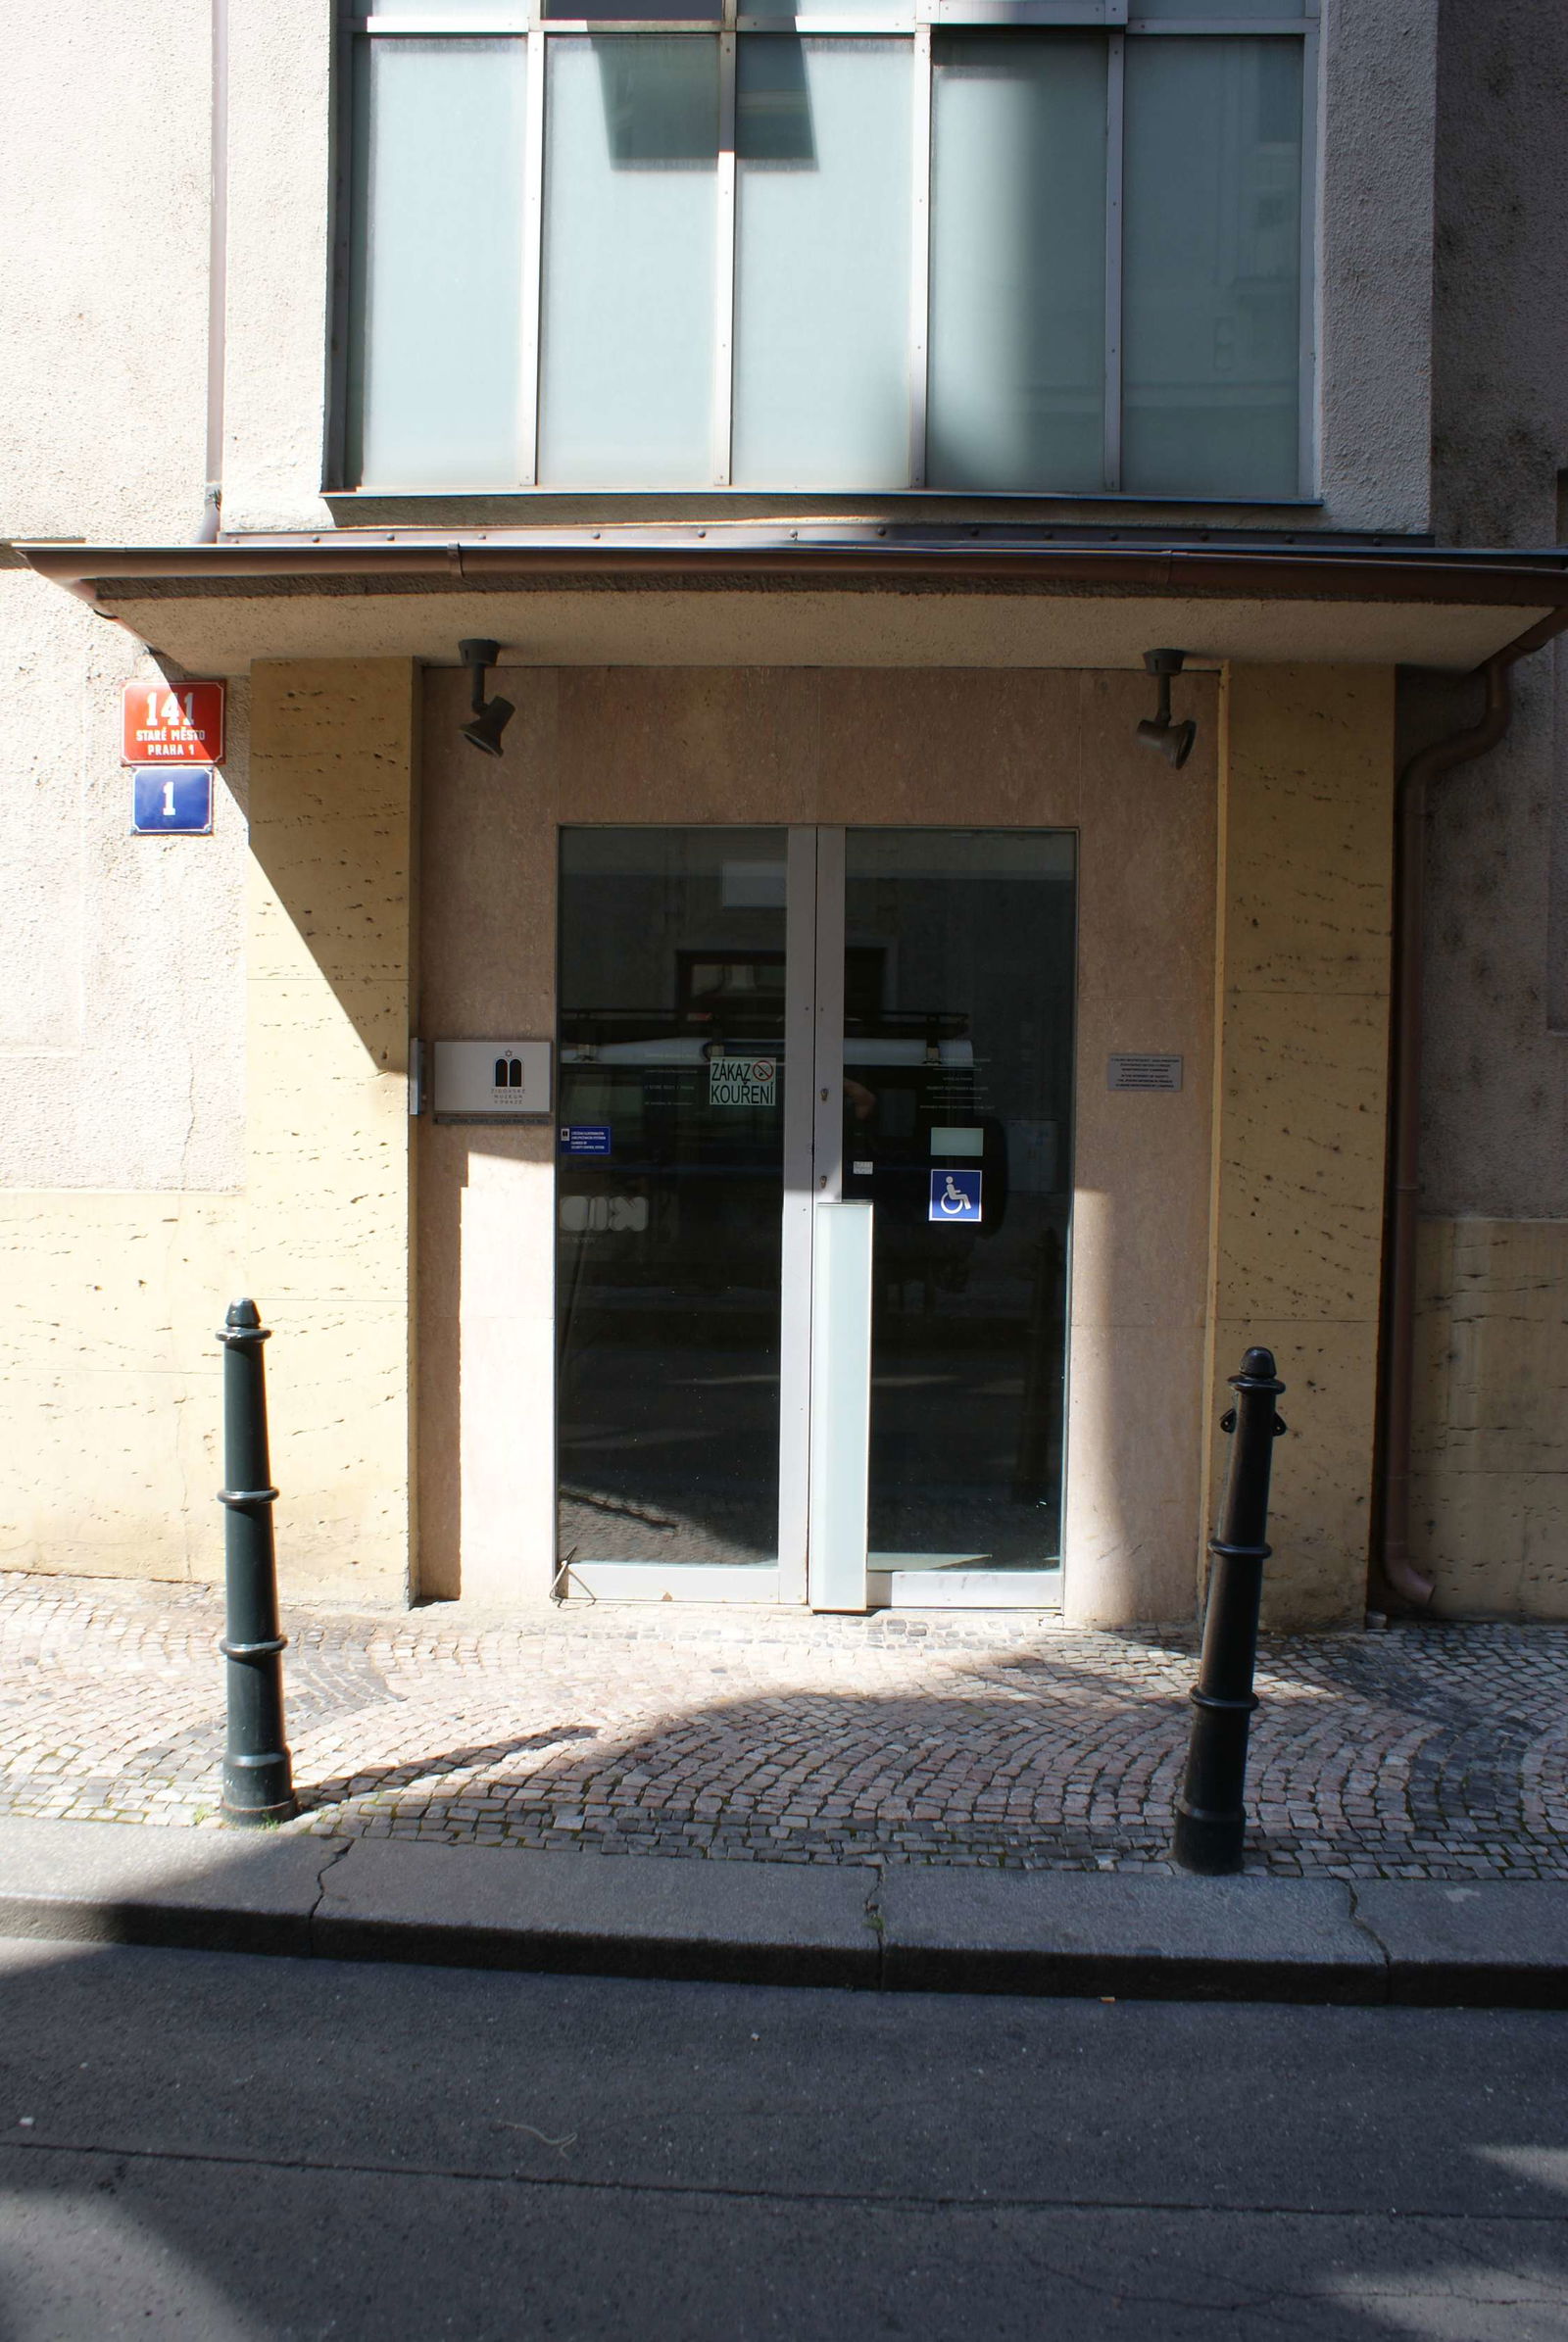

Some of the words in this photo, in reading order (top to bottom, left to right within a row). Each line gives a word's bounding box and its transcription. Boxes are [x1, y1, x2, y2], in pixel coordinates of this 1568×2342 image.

[146, 692, 195, 726] 141
[135, 727, 167, 742] STARÉ
[171, 728, 206, 742] MĚSTO
[148, 745, 184, 756] PRAHA
[189, 745, 195, 756] 1
[163, 781, 176, 816] 1
[711, 1059, 752, 1082] ZÁKAZ
[710, 1081, 773, 1104] KOUŘENÍ
